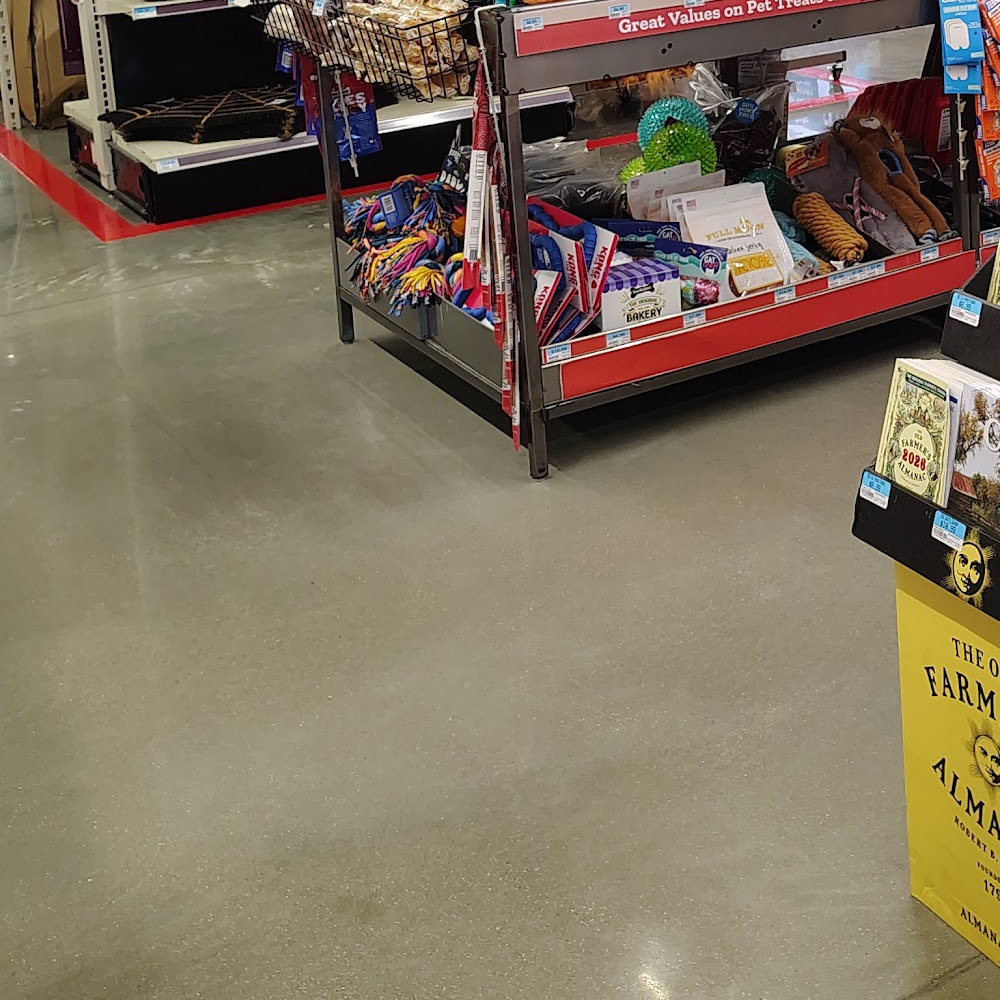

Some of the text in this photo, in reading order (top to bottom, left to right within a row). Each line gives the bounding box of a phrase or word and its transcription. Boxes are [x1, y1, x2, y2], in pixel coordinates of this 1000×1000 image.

[618, 16, 666, 35] Great
[667, 8, 722, 27] Values
[724, 6, 744, 18] on
[626, 307, 662, 323] BAKERY
[951, 637, 985, 670] THE
[954, 815, 988, 853] ROBERT
